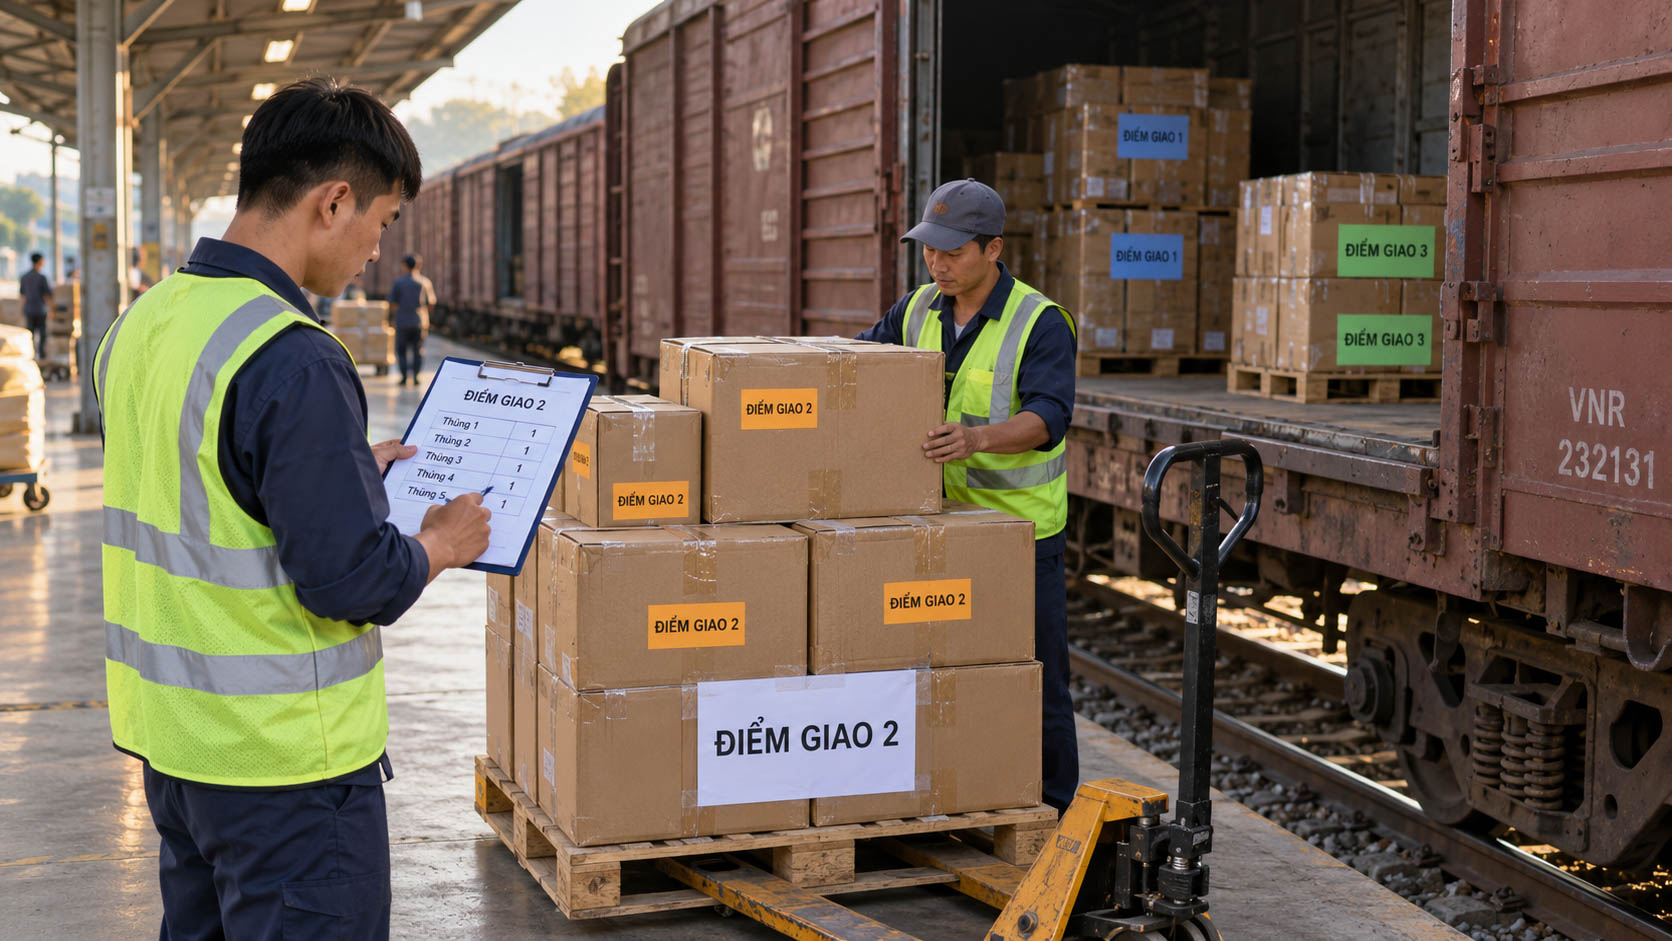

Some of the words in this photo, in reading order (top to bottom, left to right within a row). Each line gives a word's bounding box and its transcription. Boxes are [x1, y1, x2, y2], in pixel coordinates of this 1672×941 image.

[1152, 131, 1176, 143] GIAO
[1178, 132, 1183, 143] 1
[1145, 250, 1169, 262] GIAO
[1173, 251, 1177, 262] 1
[1345, 238, 1380, 257] ĐIỂM
[1384, 244, 1416, 257] GIAO
[1420, 244, 1428, 257] 3
[1344, 328, 1378, 346] ĐIỂM
[1382, 333, 1414, 347] GIAO
[1417, 333, 1425, 346] 3
[464, 388, 498, 404] ĐIỂM
[501, 395, 534, 409] GIAO
[536, 400, 546, 411] 2
[746, 400, 774, 415] ĐIỂM
[777, 402, 803, 414] GIAO
[806, 402, 812, 414] 2
[1568, 386, 1625, 428] VNR
[474, 421, 479, 430] 1
[531, 429, 537, 438] 1
[464, 438, 472, 447] 2
[524, 447, 530, 455] 1
[455, 456, 463, 464] 3
[516, 464, 523, 473] 1
[1558, 438, 1654, 489] 232131
[448, 473, 455, 482] 4
[509, 482, 516, 491] 1
[438, 492, 446, 500] 5
[501, 500, 507, 509] 1
[618, 491, 645, 506] ĐIỂM
[648, 494, 675, 505] GIAO
[677, 494, 684, 504] 2
[890, 592, 921, 609] ĐIỂM
[925, 594, 955, 607] GIAO
[958, 593, 966, 605] 2
[654, 614, 689, 633] ĐIỂM
[694, 618, 727, 631] GIAO
[731, 617, 739, 630] 2
[714, 716, 790, 757] ĐIỂM
[801, 721, 873, 752] GIAO
[883, 719, 899, 747] 2
